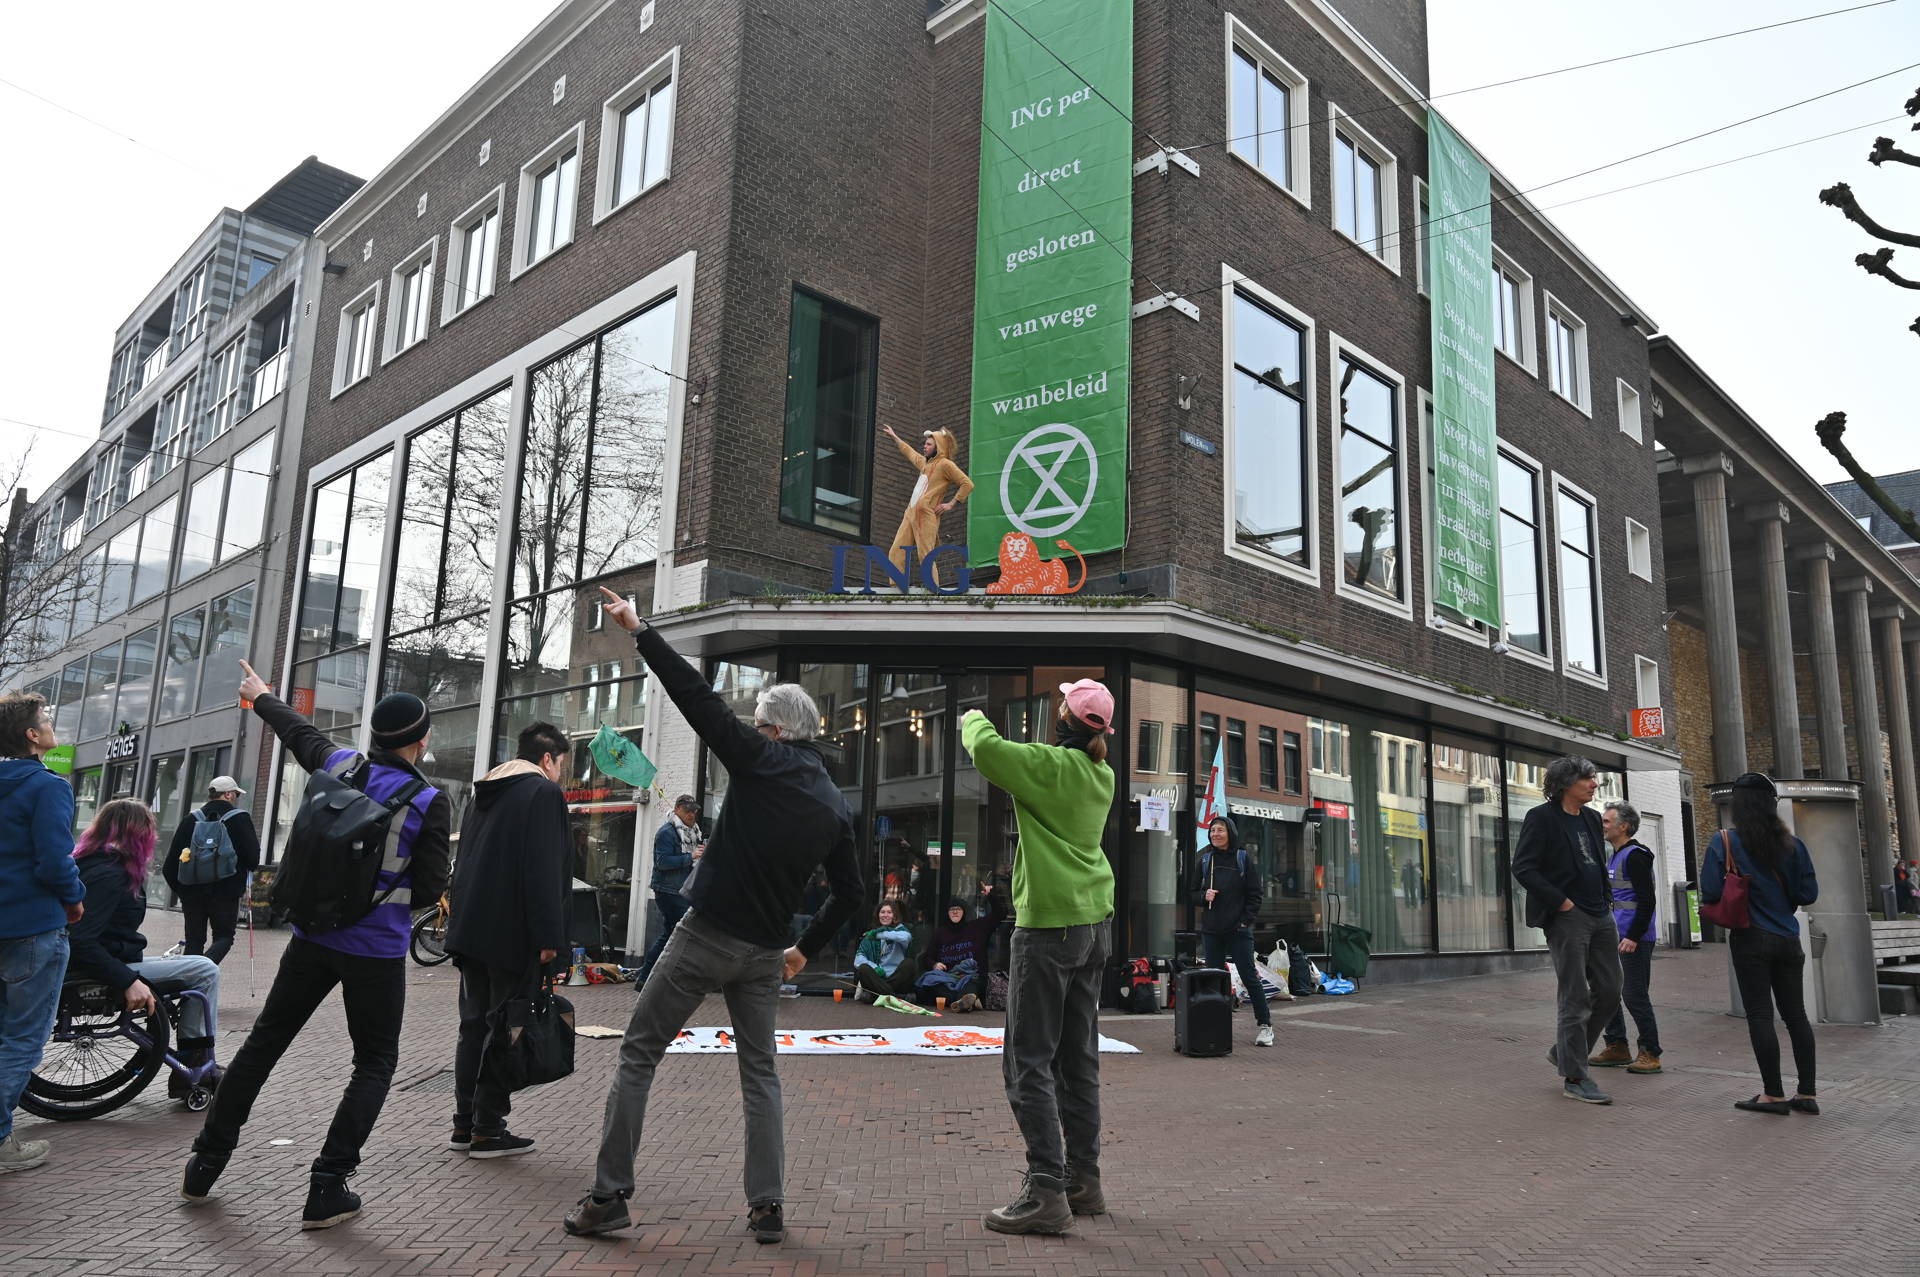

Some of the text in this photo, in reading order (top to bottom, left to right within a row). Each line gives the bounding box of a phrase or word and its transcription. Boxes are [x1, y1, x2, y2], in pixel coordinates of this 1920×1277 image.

[1010, 85, 1095, 130] ING per
[1017, 157, 1082, 194] direct
[1443, 190, 1463, 225] Stop
[1006, 228, 1096, 272] gesloten
[1439, 212, 1487, 271] investeren
[1445, 245, 1484, 292] in fossiel
[998, 303, 1098, 341] vanwege
[1444, 302, 1466, 334] Stop
[1439, 326, 1488, 378] investeren
[991, 372, 1108, 417] wanbeleid
[1441, 362, 1490, 407] in wapens
[1443, 417, 1486, 460] Stop met
[1439, 446, 1490, 492] investeren
[1442, 478, 1490, 519] in illegale
[826, 544, 974, 595] ING
[1439, 545, 1487, 576] nederzet-
[1447, 572, 1480, 605] tingen
